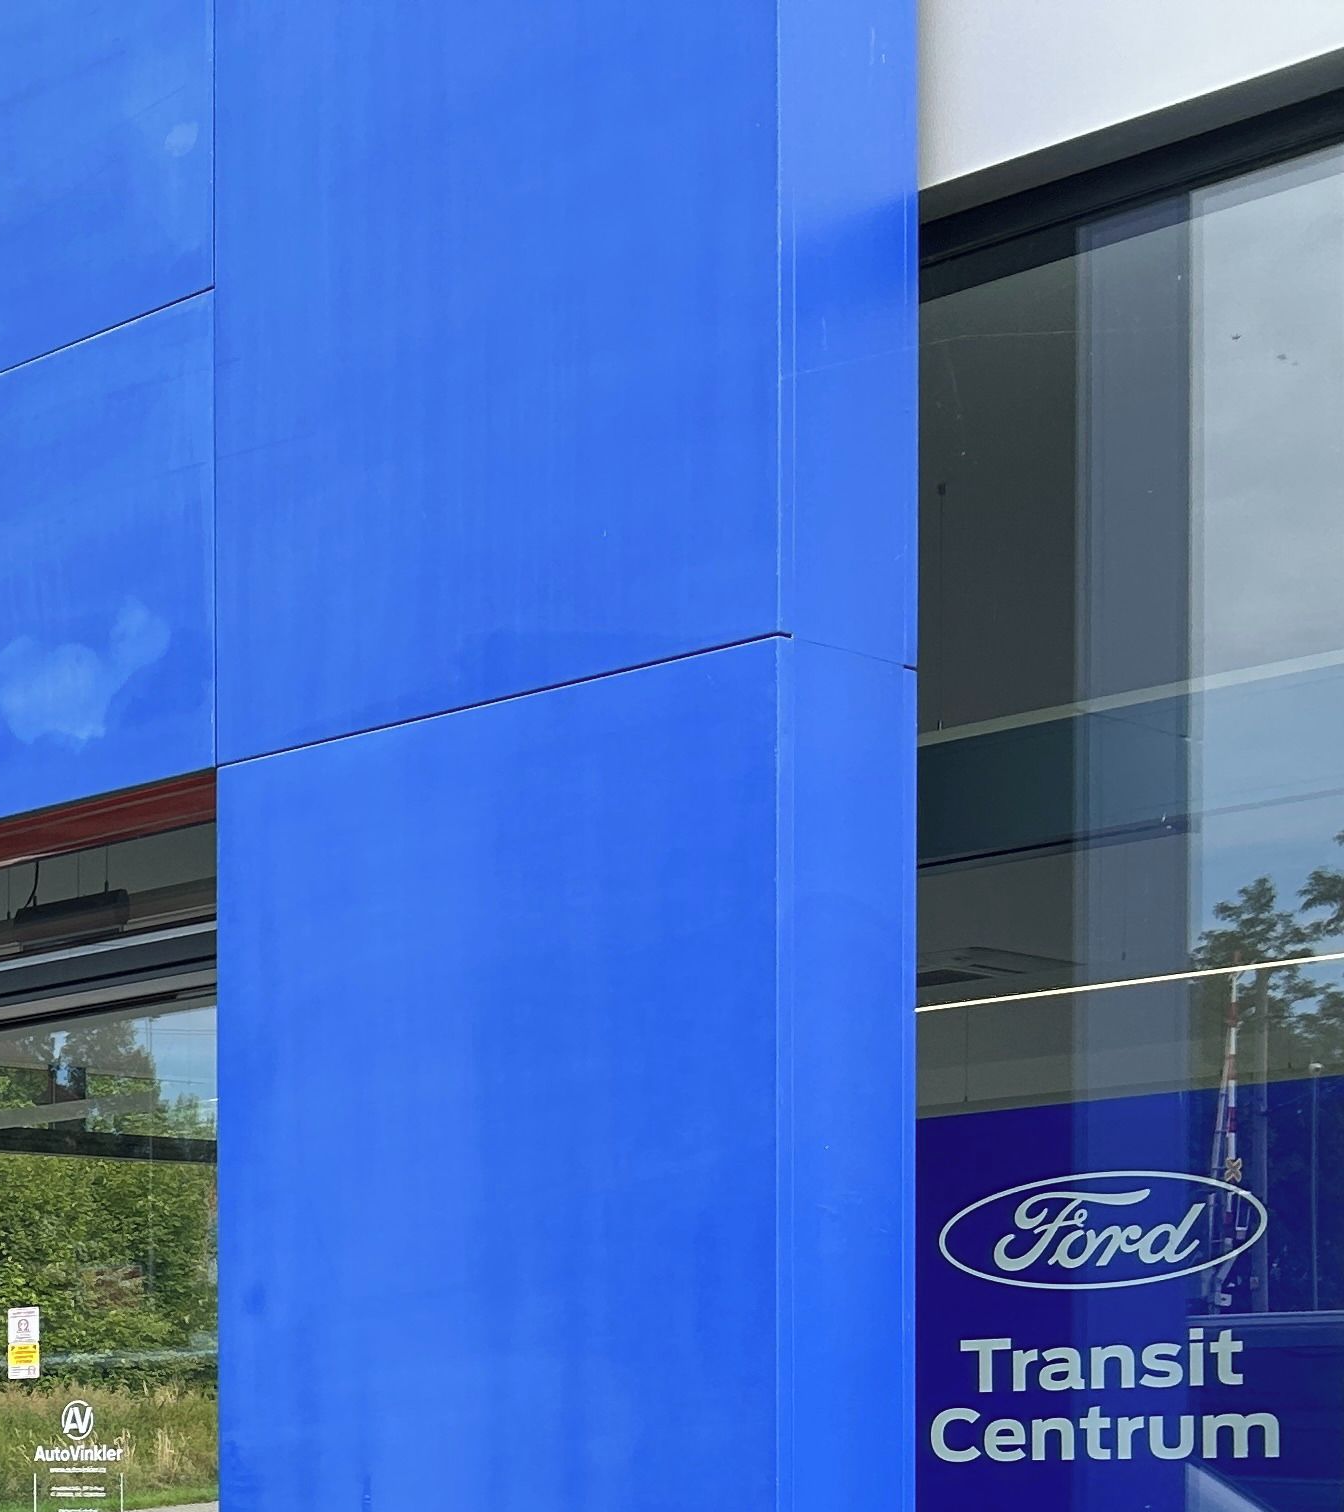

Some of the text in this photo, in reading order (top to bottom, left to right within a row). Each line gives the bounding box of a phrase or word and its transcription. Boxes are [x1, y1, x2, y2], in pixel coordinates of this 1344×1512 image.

[993, 1188, 1206, 1272] Ford
[960, 1328, 1244, 1393] Transit
[33, 1444, 123, 1462] AutoVinkler
[930, 1406, 1280, 1463] Centrum
